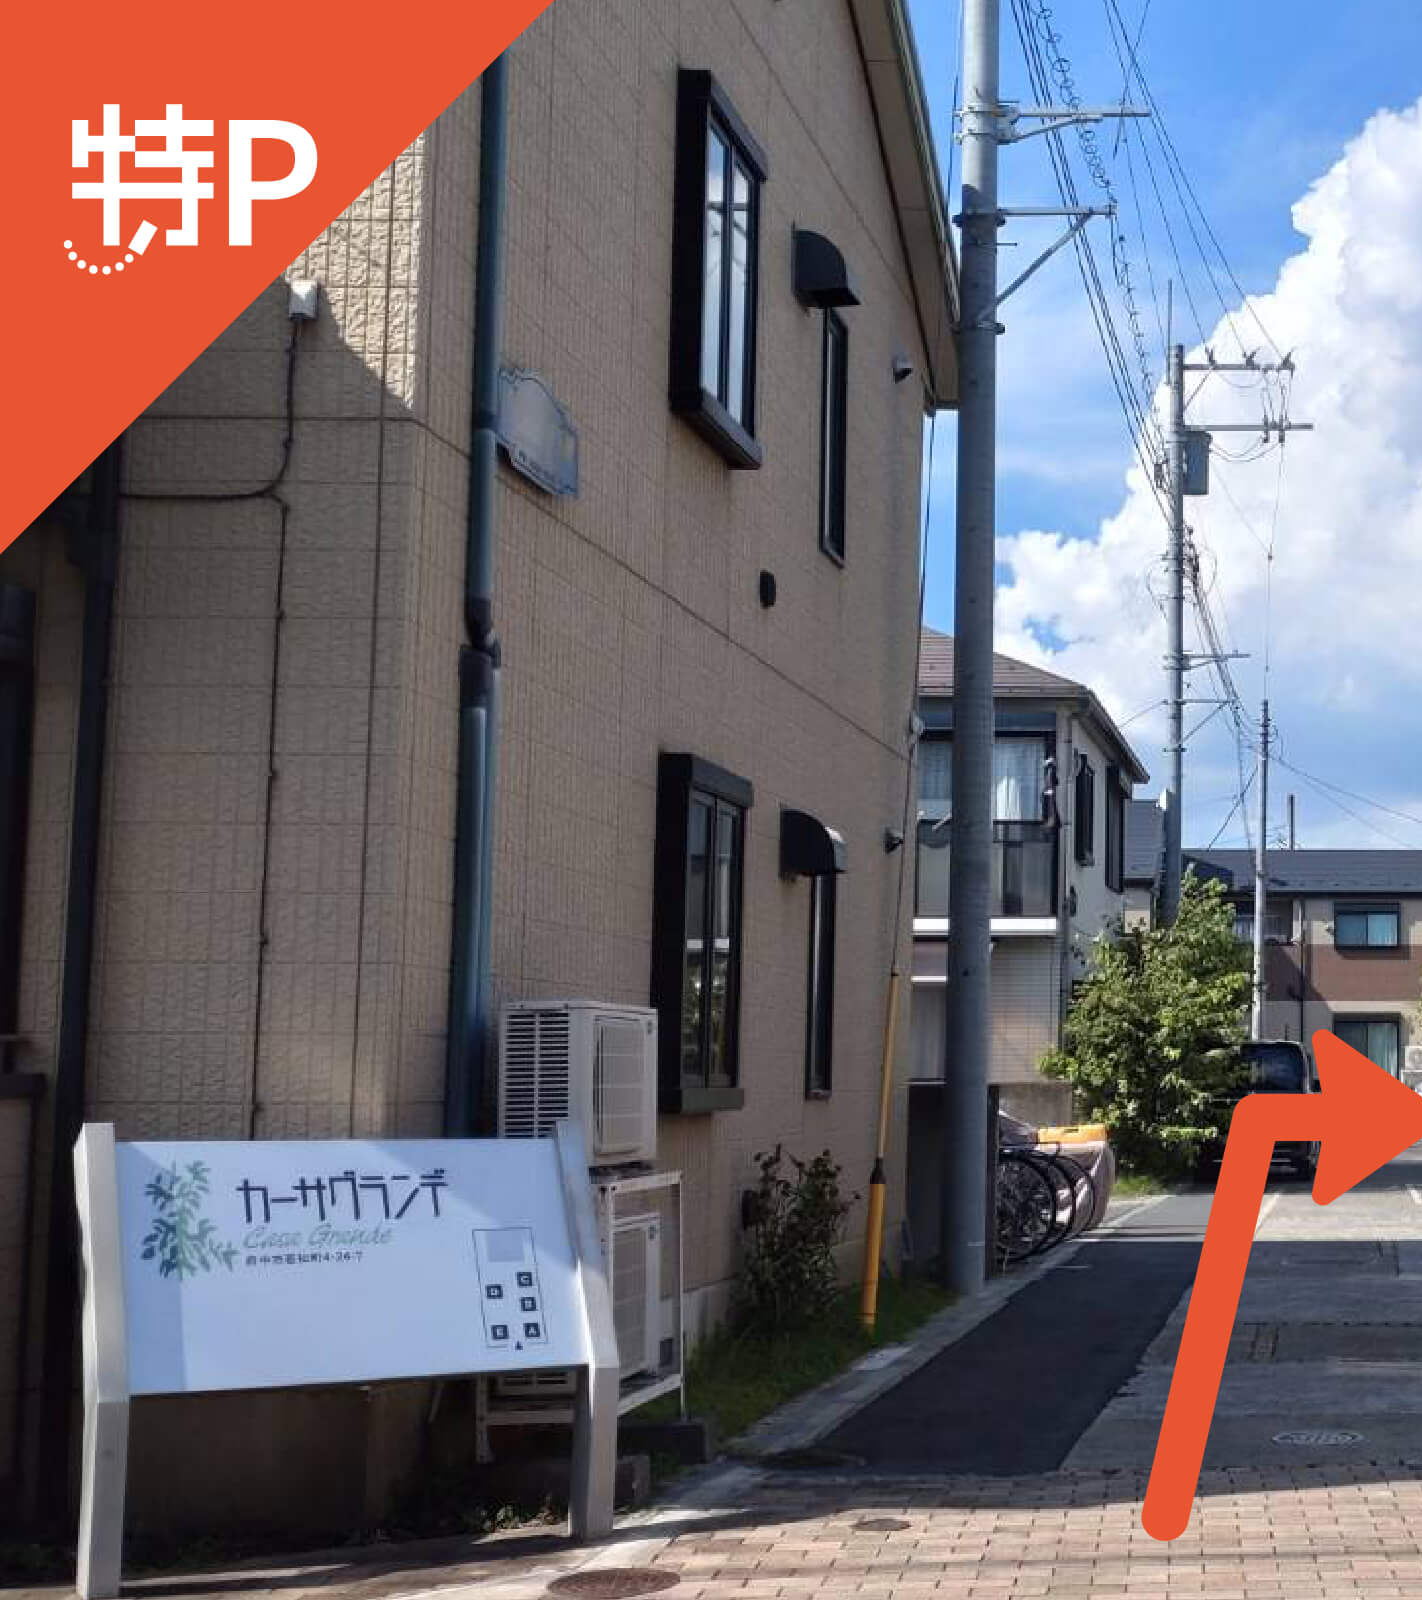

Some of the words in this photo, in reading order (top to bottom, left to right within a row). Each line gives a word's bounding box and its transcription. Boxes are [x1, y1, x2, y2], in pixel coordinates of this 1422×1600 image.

[236, 1168, 448, 1223] カーサグランデ
[243, 1225, 301, 1249] Casa
[308, 1218, 392, 1247] Grande
